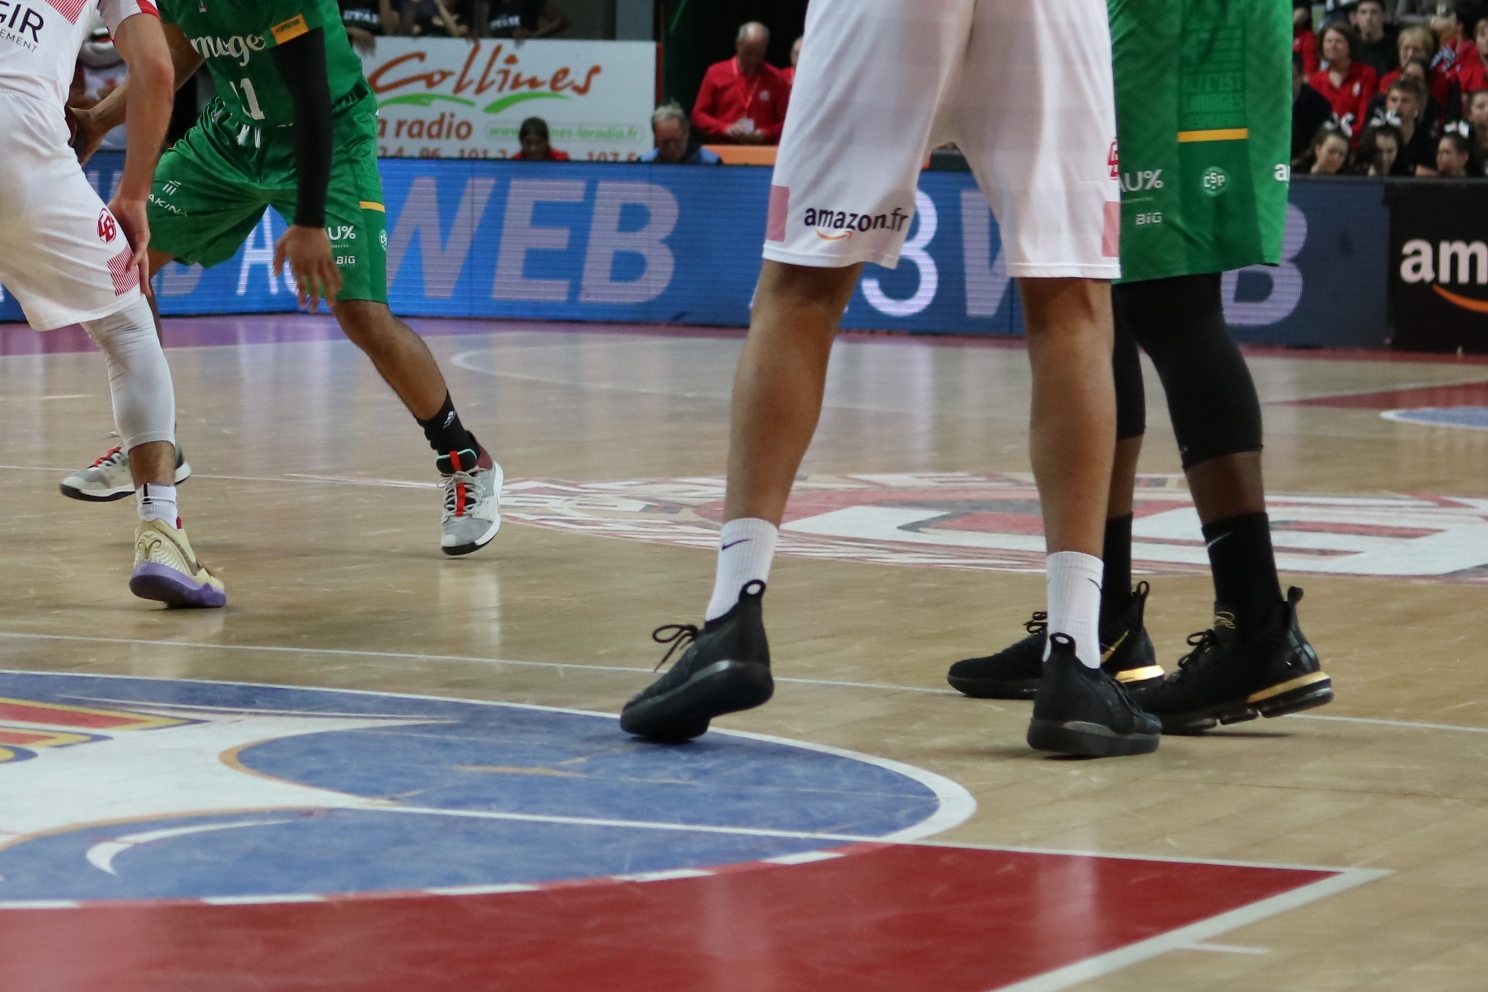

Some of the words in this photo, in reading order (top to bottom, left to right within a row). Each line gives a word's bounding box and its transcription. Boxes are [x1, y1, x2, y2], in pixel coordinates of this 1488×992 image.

[369, 43, 602, 96] Collines
[395, 112, 473, 140] radio
[804, 208, 909, 232] amazon.fr
